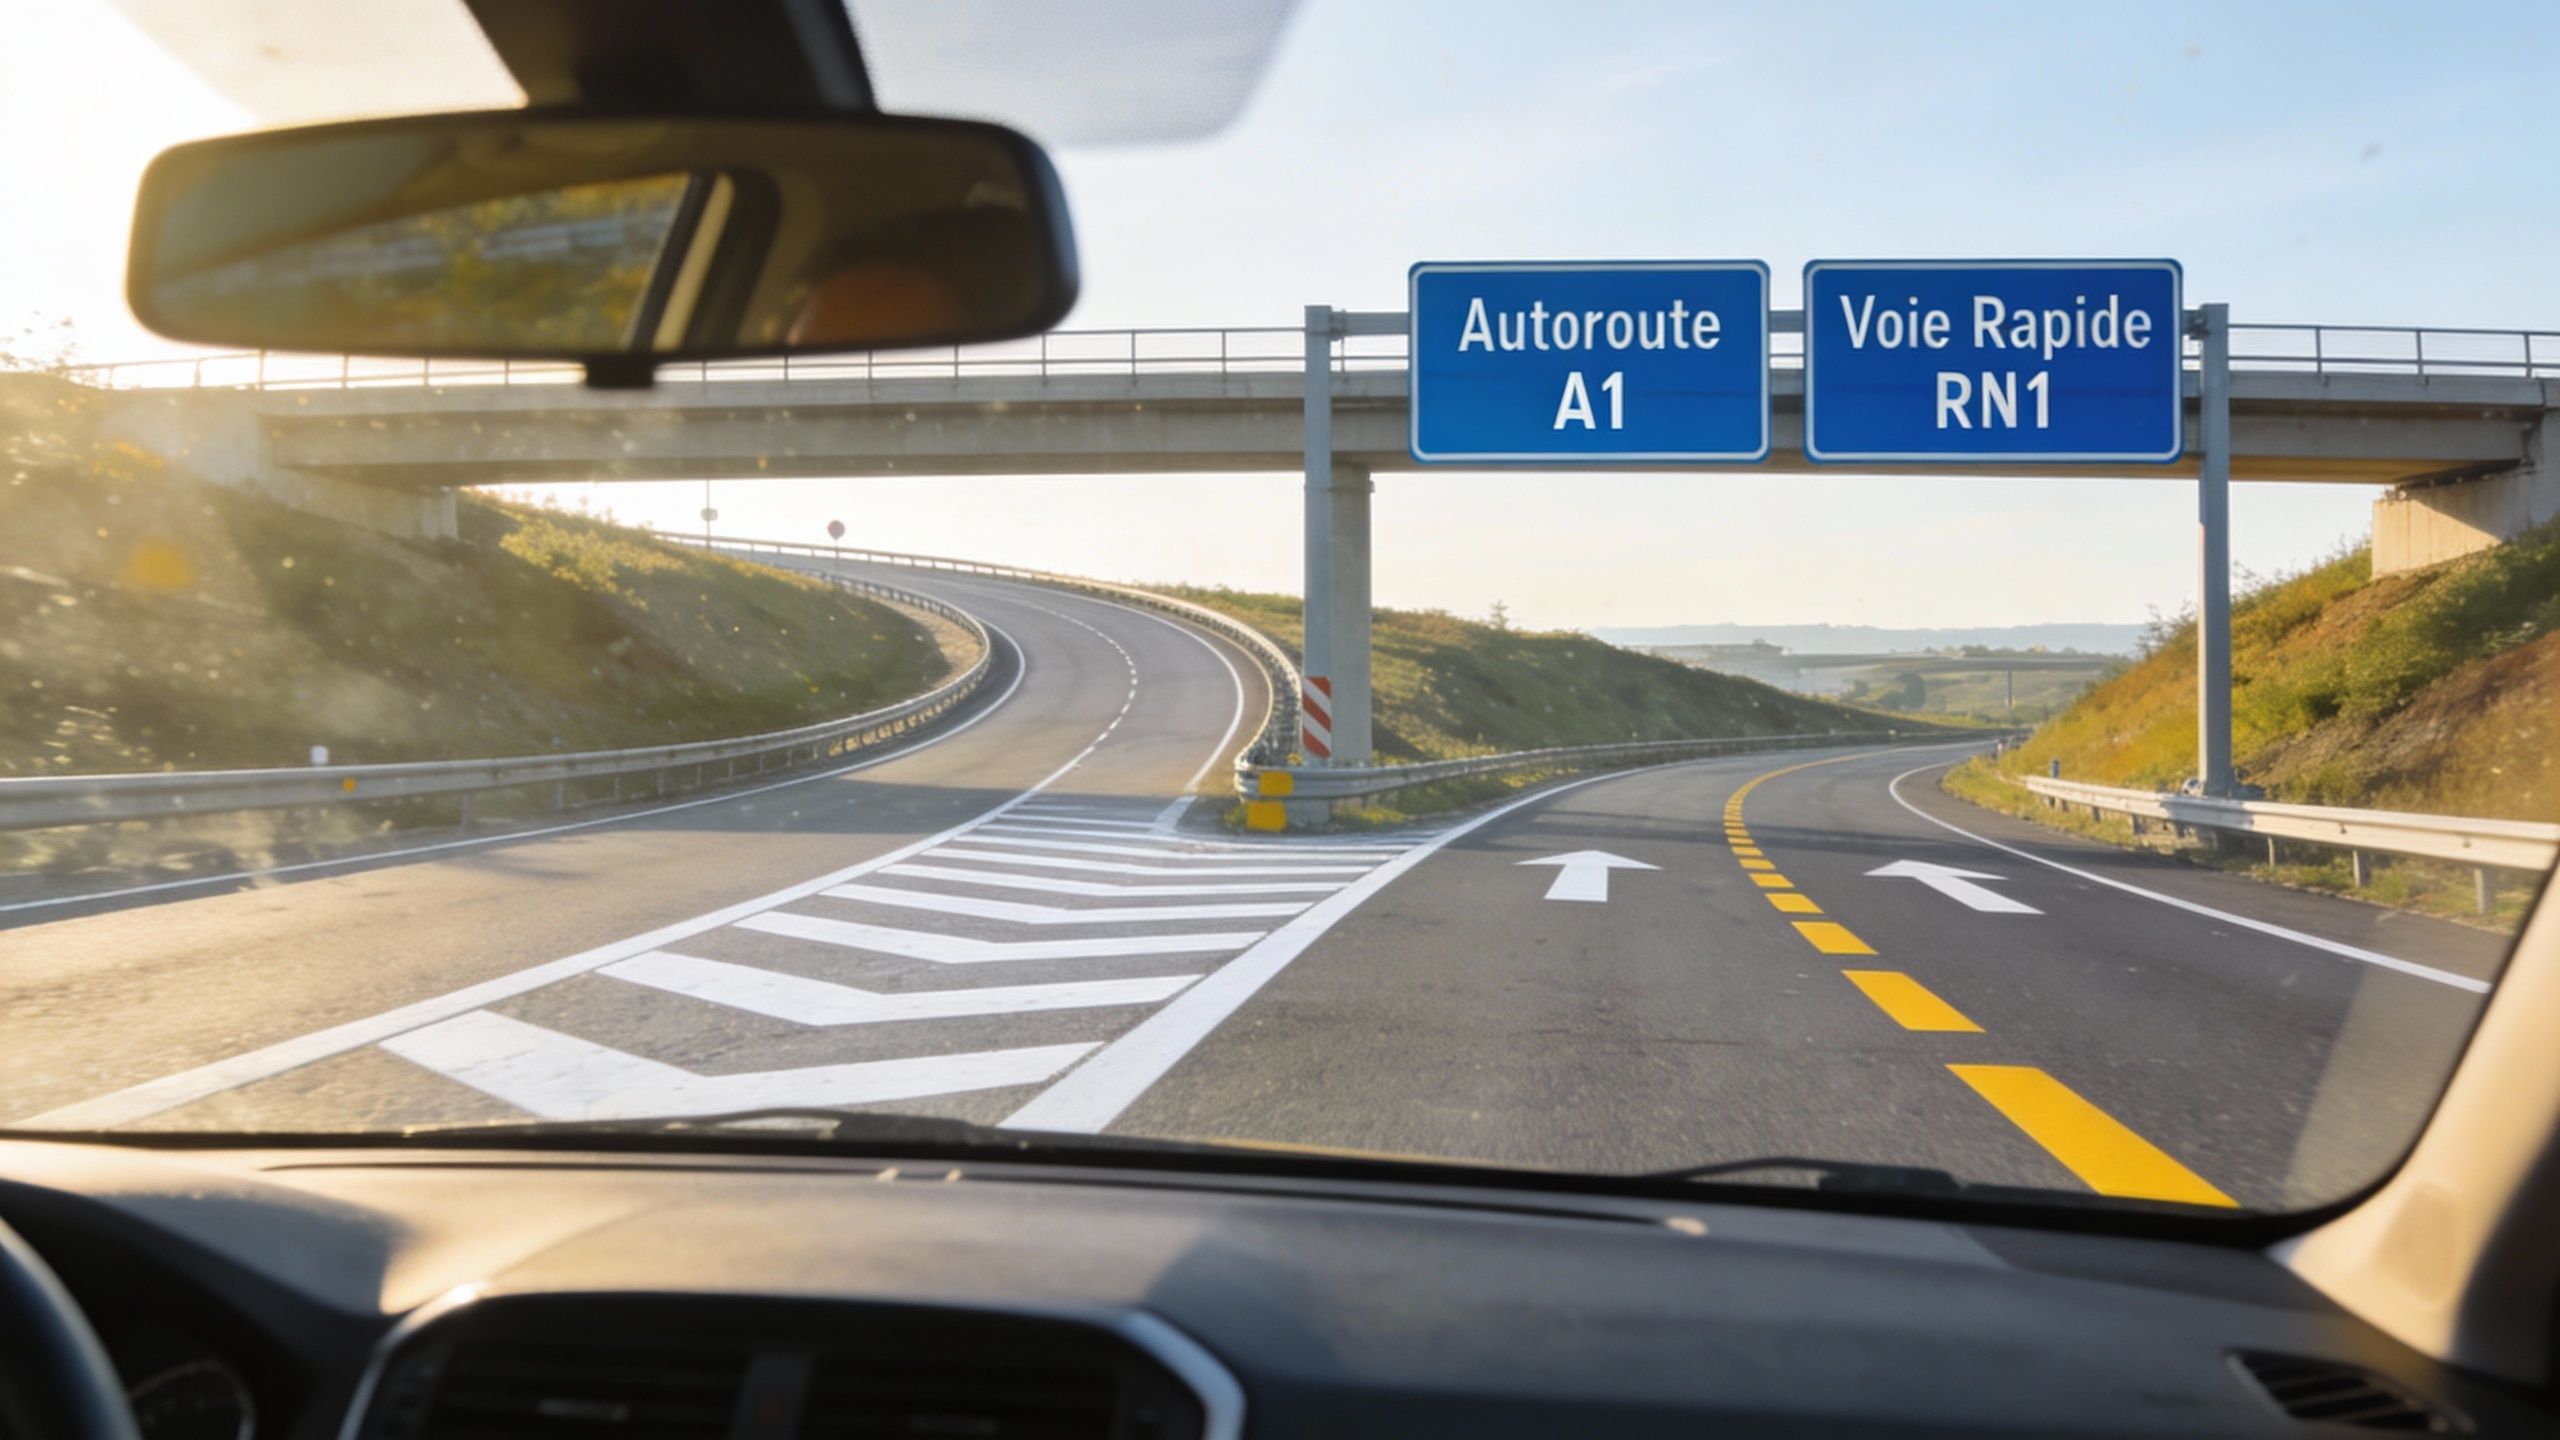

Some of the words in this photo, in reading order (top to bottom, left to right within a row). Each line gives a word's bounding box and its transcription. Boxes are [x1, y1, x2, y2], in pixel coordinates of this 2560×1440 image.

[1458, 296, 1722, 352] Autoroute
[1839, 294, 1951, 350] Voie
[1972, 293, 2152, 362] Rapide
[1552, 370, 1625, 431] A1
[1936, 370, 2051, 430] RN1
